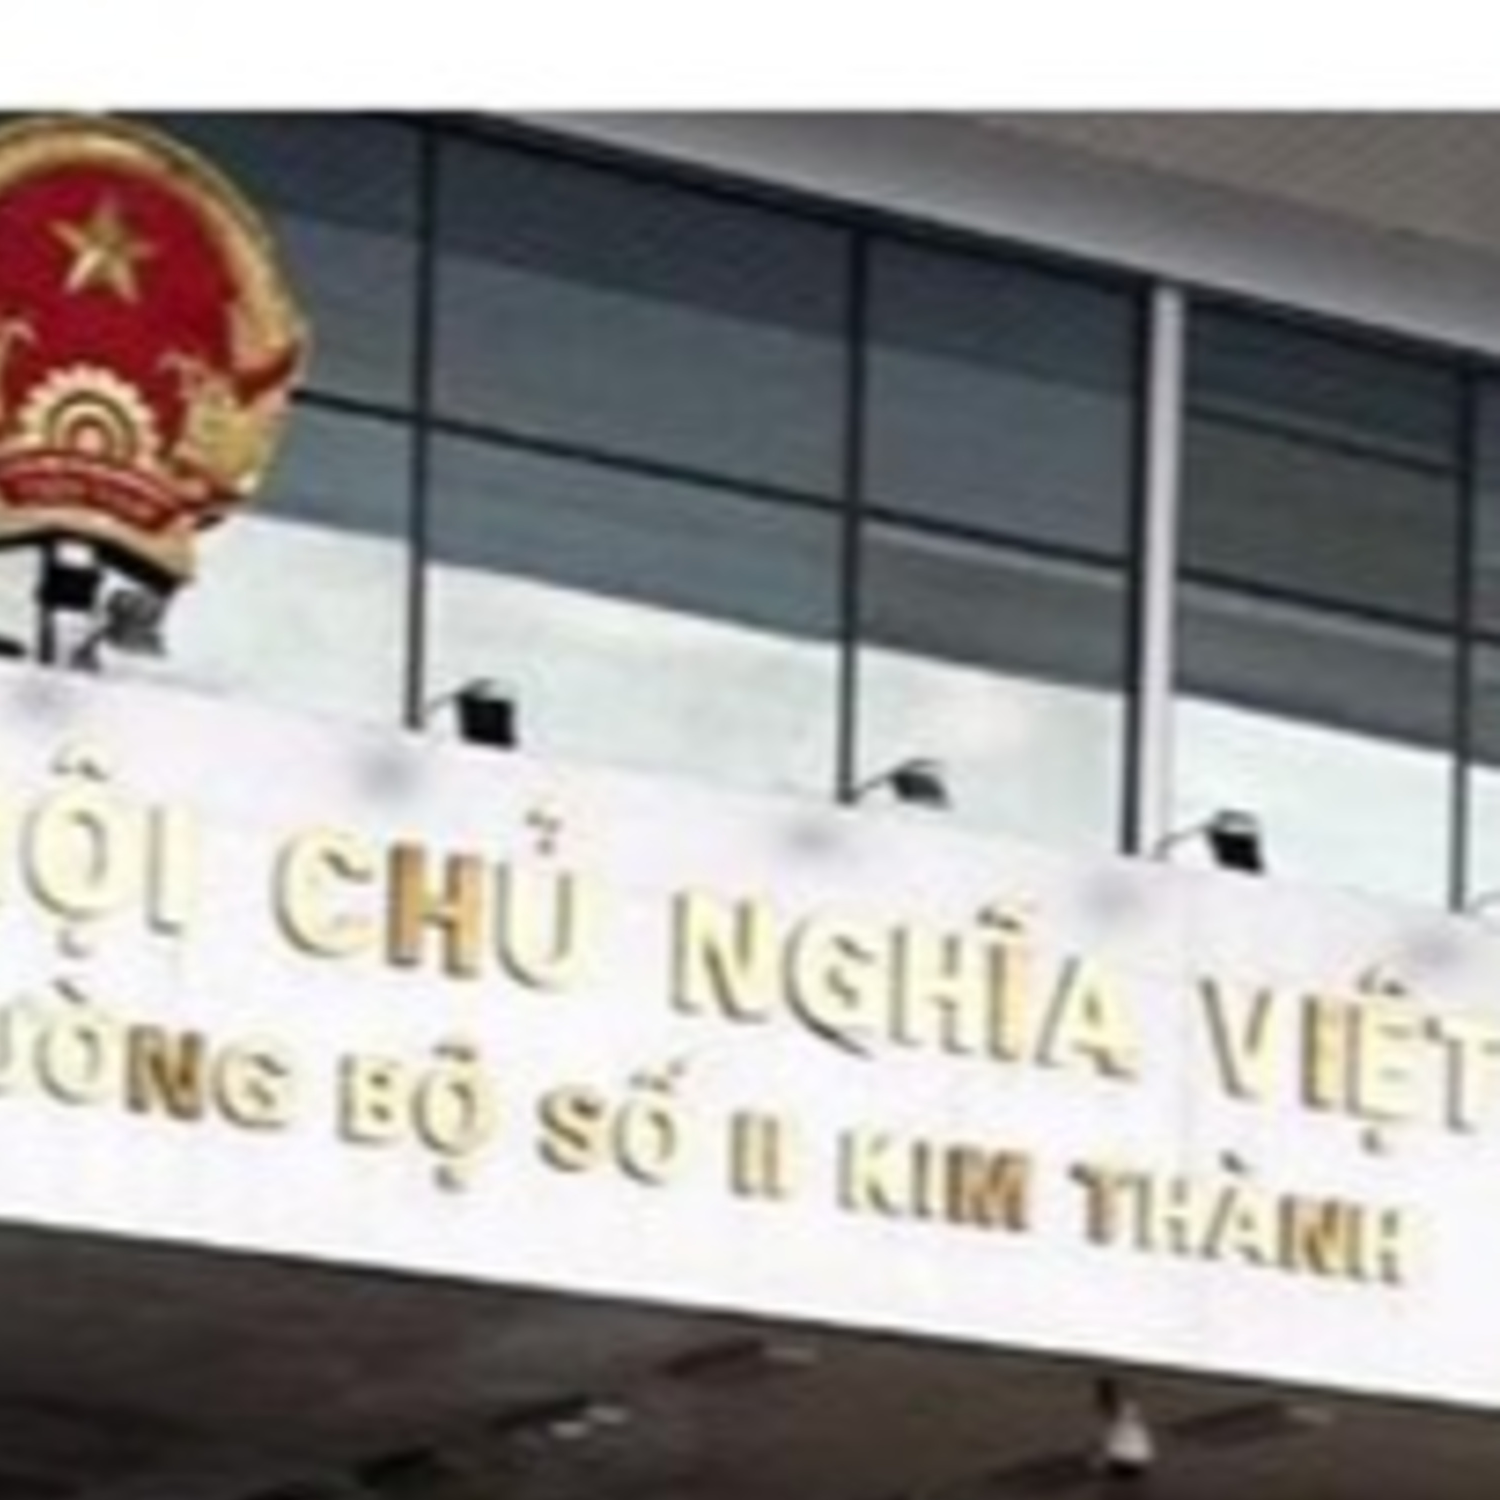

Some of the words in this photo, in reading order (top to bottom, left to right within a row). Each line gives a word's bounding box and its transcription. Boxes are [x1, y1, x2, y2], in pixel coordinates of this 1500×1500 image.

[267, 797, 586, 993] CHỦ
[668, 888, 1141, 1087] NGHĨA
[1198, 964, 1500, 1158] VIỆT
[332, 1030, 498, 1196] BỘ
[532, 1053, 687, 1190] SỐ
[835, 1124, 1035, 1237] KIM
[1067, 1148, 1416, 1288] THÀNH
